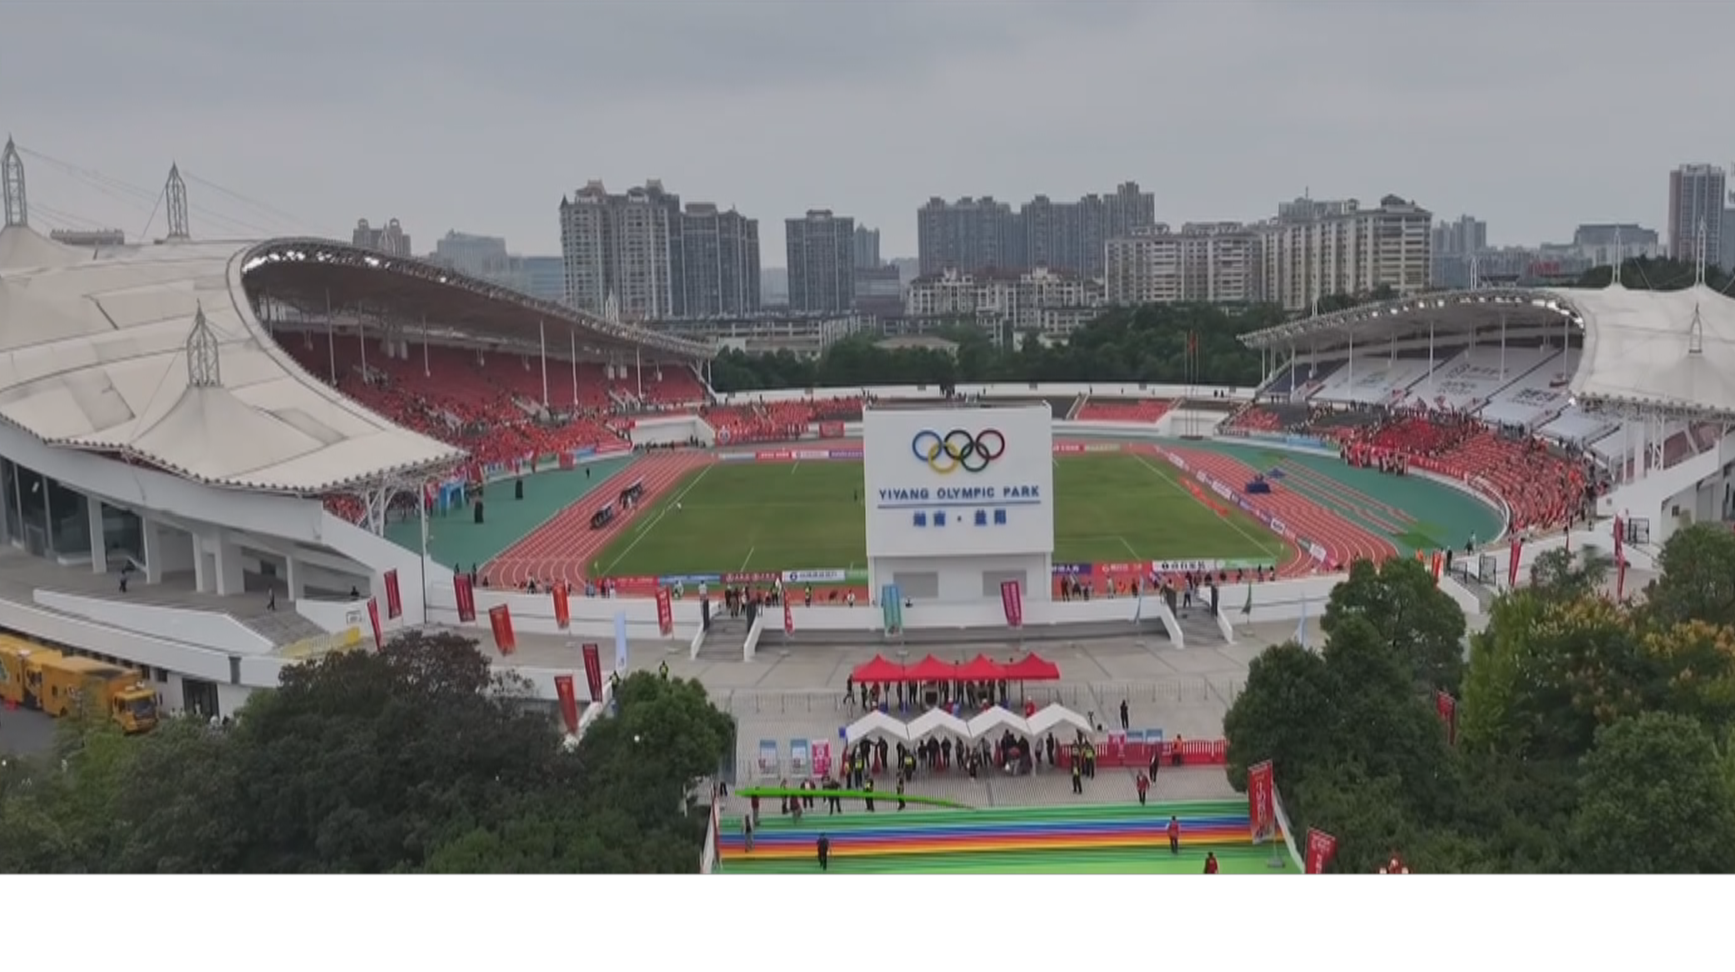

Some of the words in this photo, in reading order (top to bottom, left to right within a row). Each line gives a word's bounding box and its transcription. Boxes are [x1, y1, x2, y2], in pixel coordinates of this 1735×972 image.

[879, 488, 929, 500] YIYANG
[937, 486, 995, 499] OLYMPIC
[1003, 485, 1040, 497] PARK
